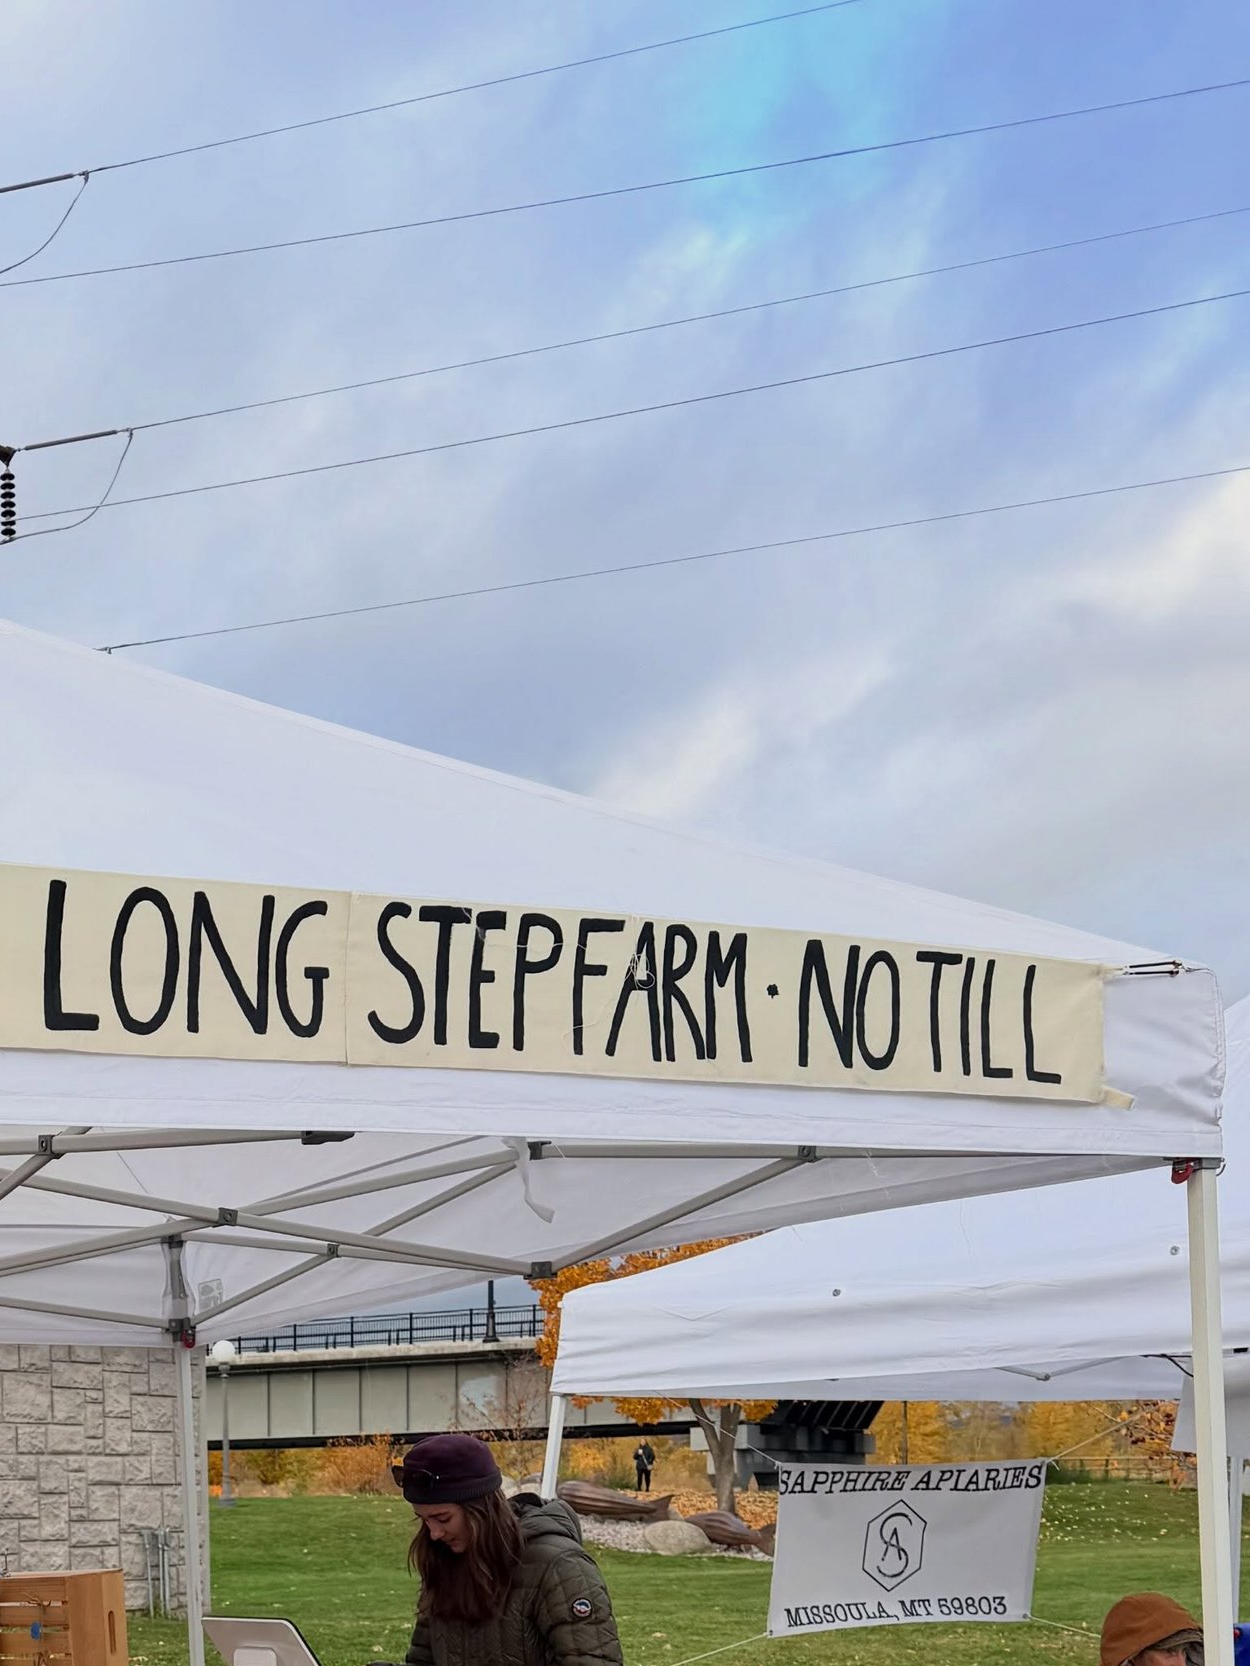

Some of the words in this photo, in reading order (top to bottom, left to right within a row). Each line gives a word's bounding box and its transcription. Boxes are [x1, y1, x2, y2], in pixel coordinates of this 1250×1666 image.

[44, 879, 329, 1037] LONG
[779, 1470, 911, 1495] SAPPHIRE
[910, 1464, 1043, 1491] APIARIES
[784, 1600, 900, 1628] MISSOULA,
[898, 1598, 934, 1618] MT
[938, 1596, 1007, 1616] 59803
